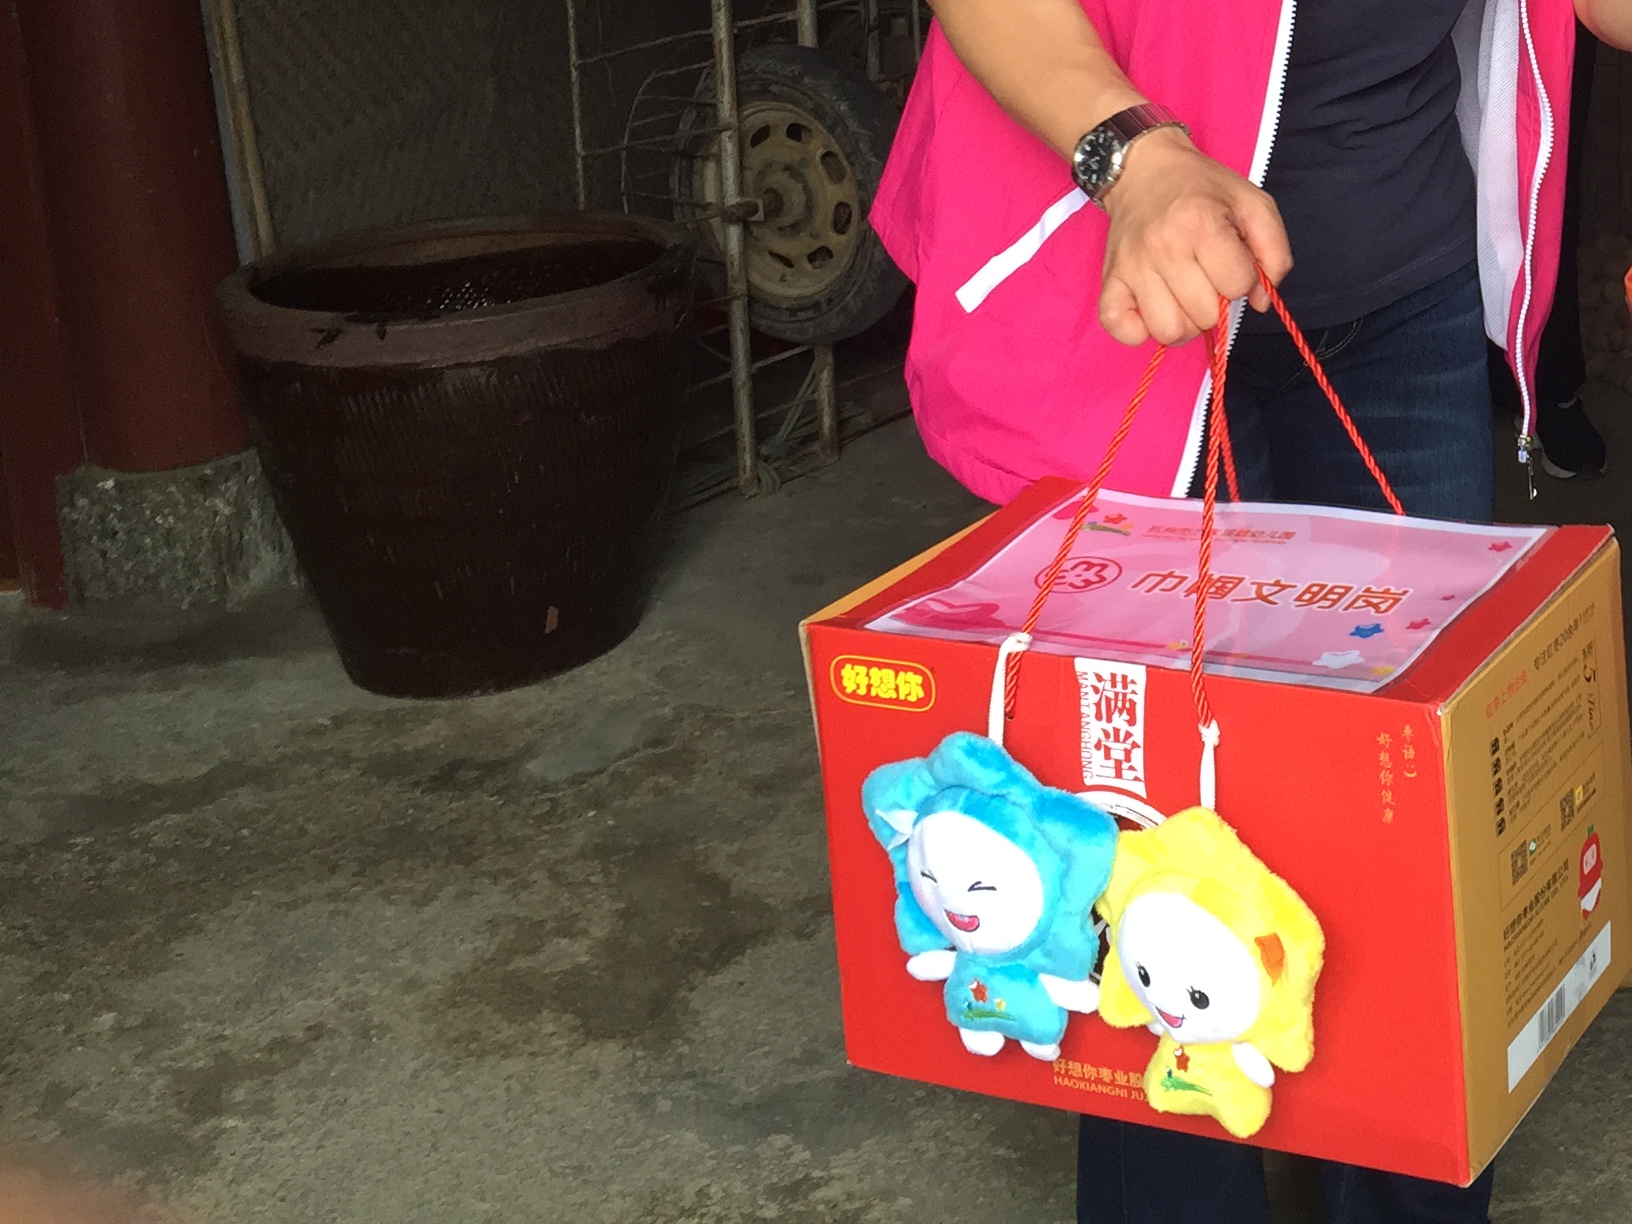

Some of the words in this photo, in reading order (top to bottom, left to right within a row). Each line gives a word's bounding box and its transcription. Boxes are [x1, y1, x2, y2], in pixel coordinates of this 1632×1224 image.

[1131, 570, 1411, 614] 巾帼文明岗
[841, 663, 925, 703] 好想你
[1090, 672, 1145, 783] 满堂
[1053, 1075, 1128, 1099] HAOXIANGNI
